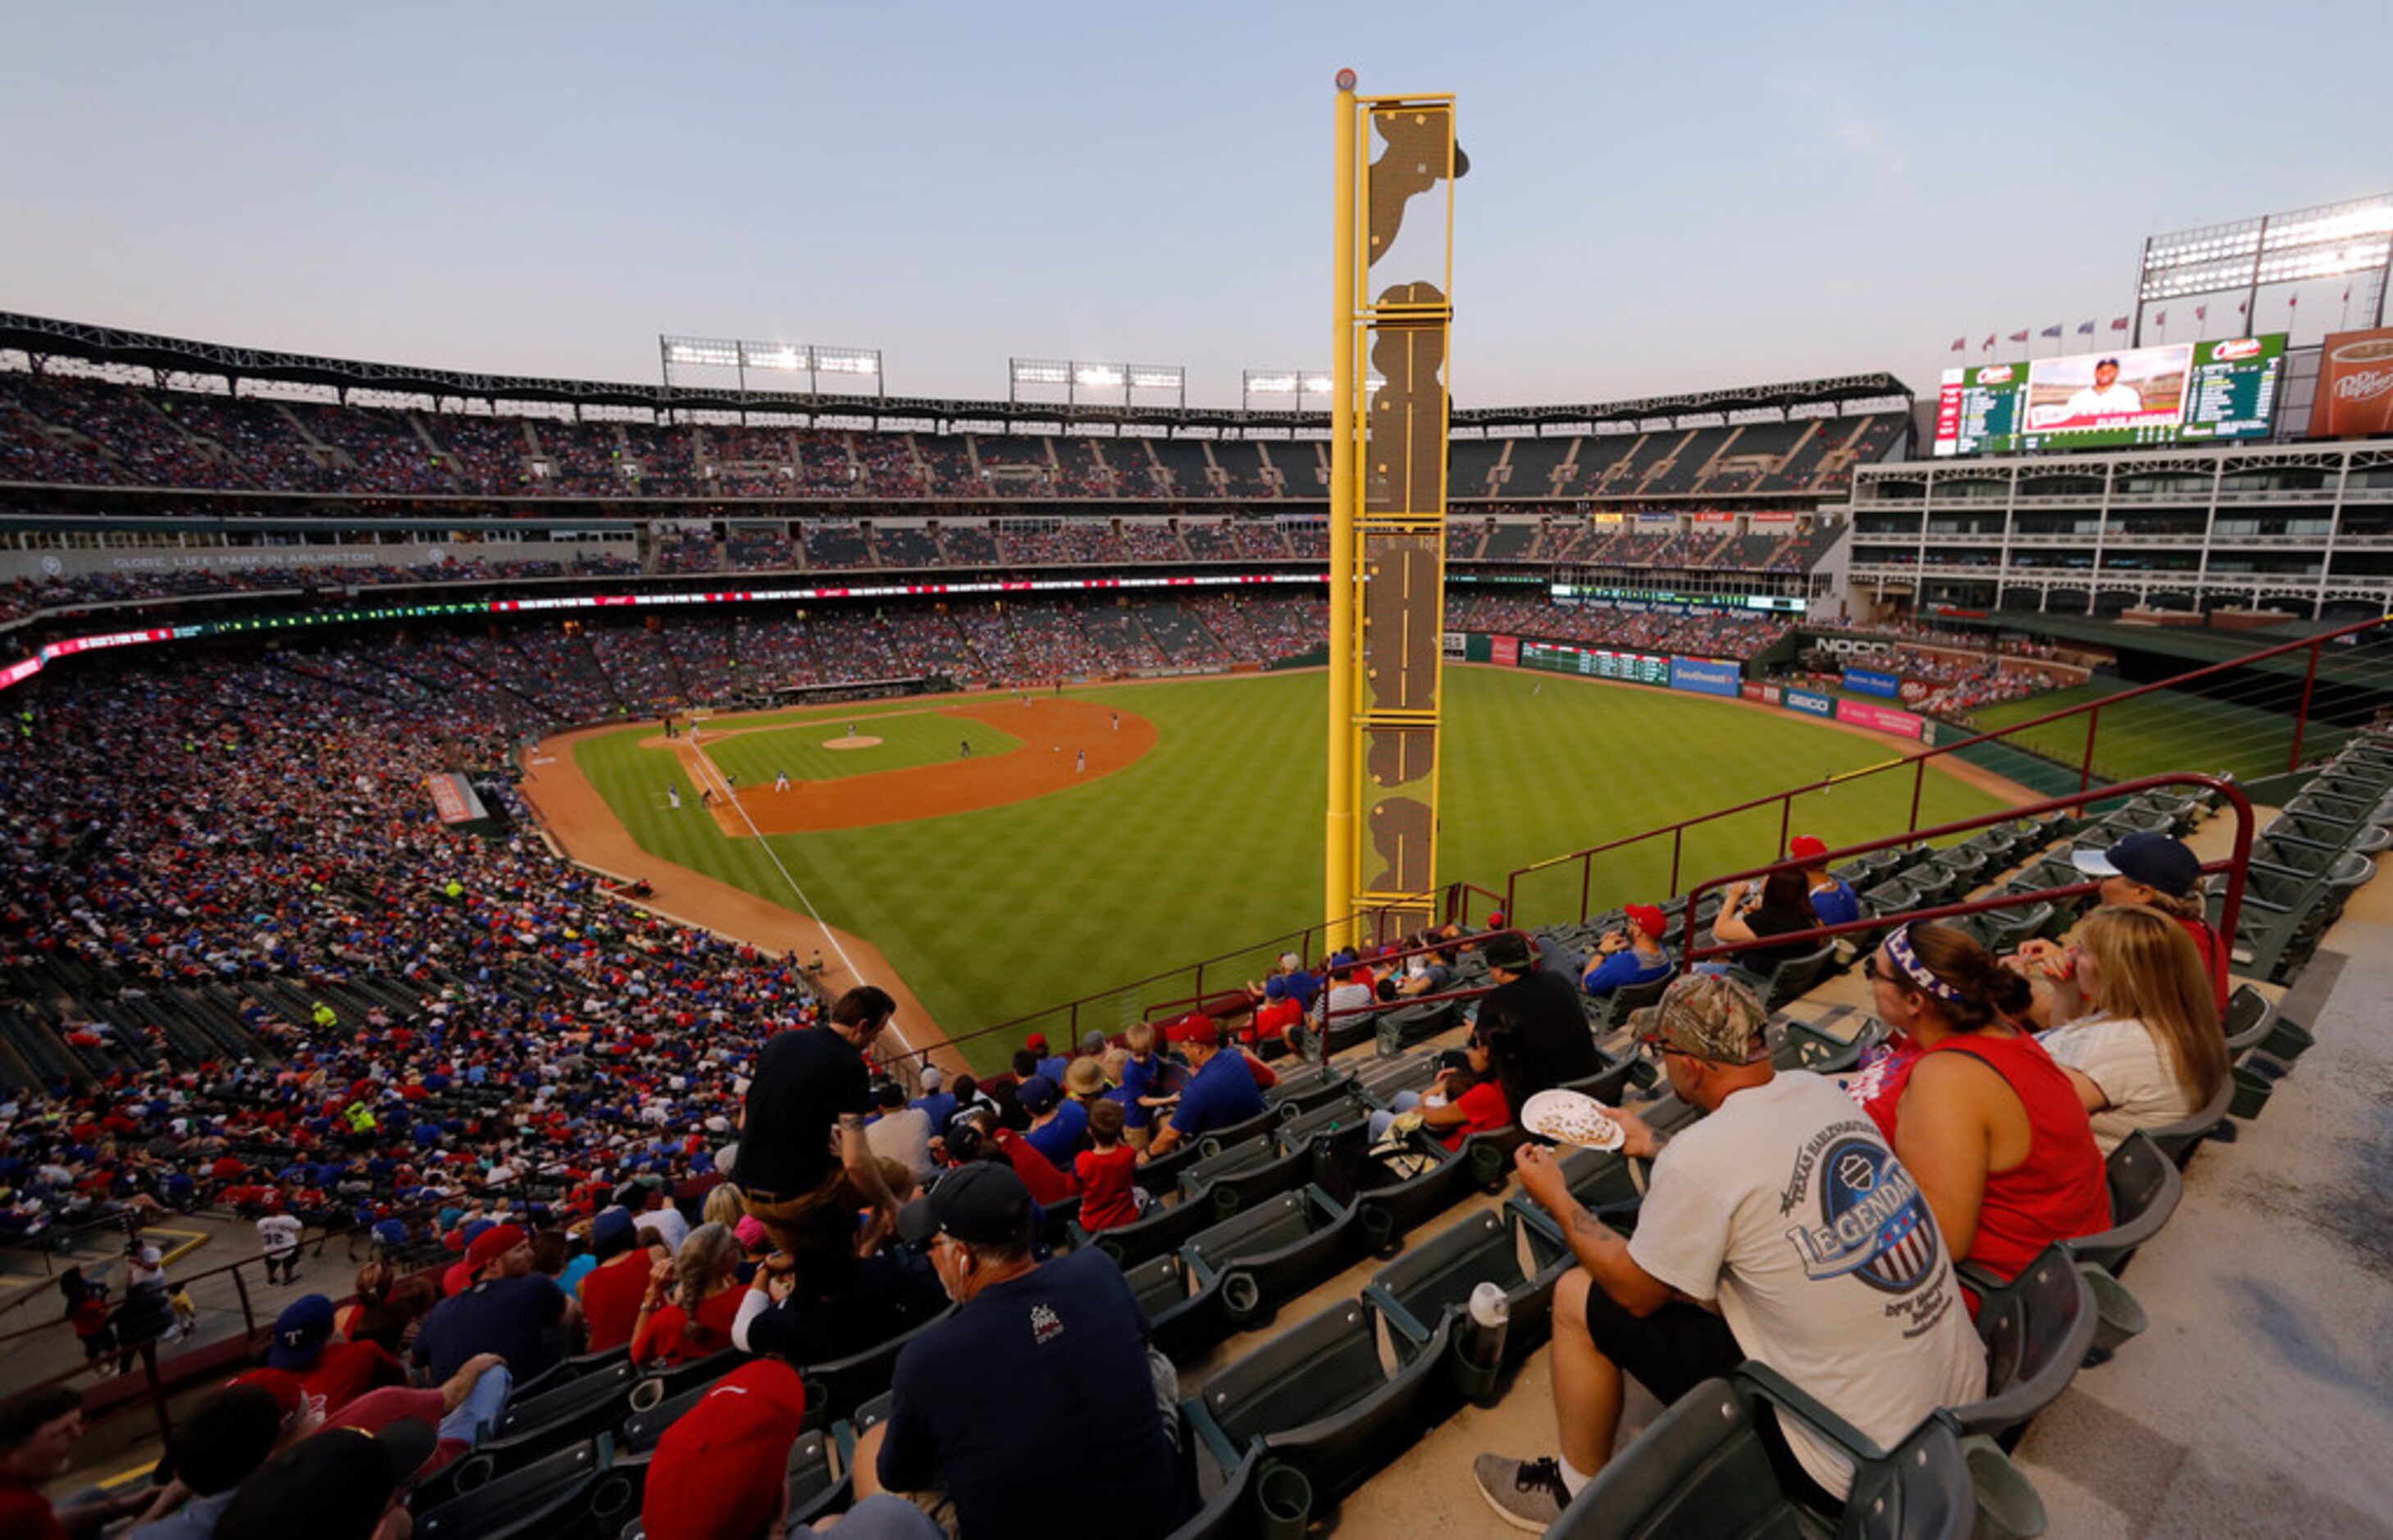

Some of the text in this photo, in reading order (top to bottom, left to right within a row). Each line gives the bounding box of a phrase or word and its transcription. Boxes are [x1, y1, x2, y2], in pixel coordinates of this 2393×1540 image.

[113, 553, 375, 568] GLOBE LIFE PARK IN ARLINGTON
[1787, 694, 1829, 713] GEICO
[284, 1329, 303, 1346] T
